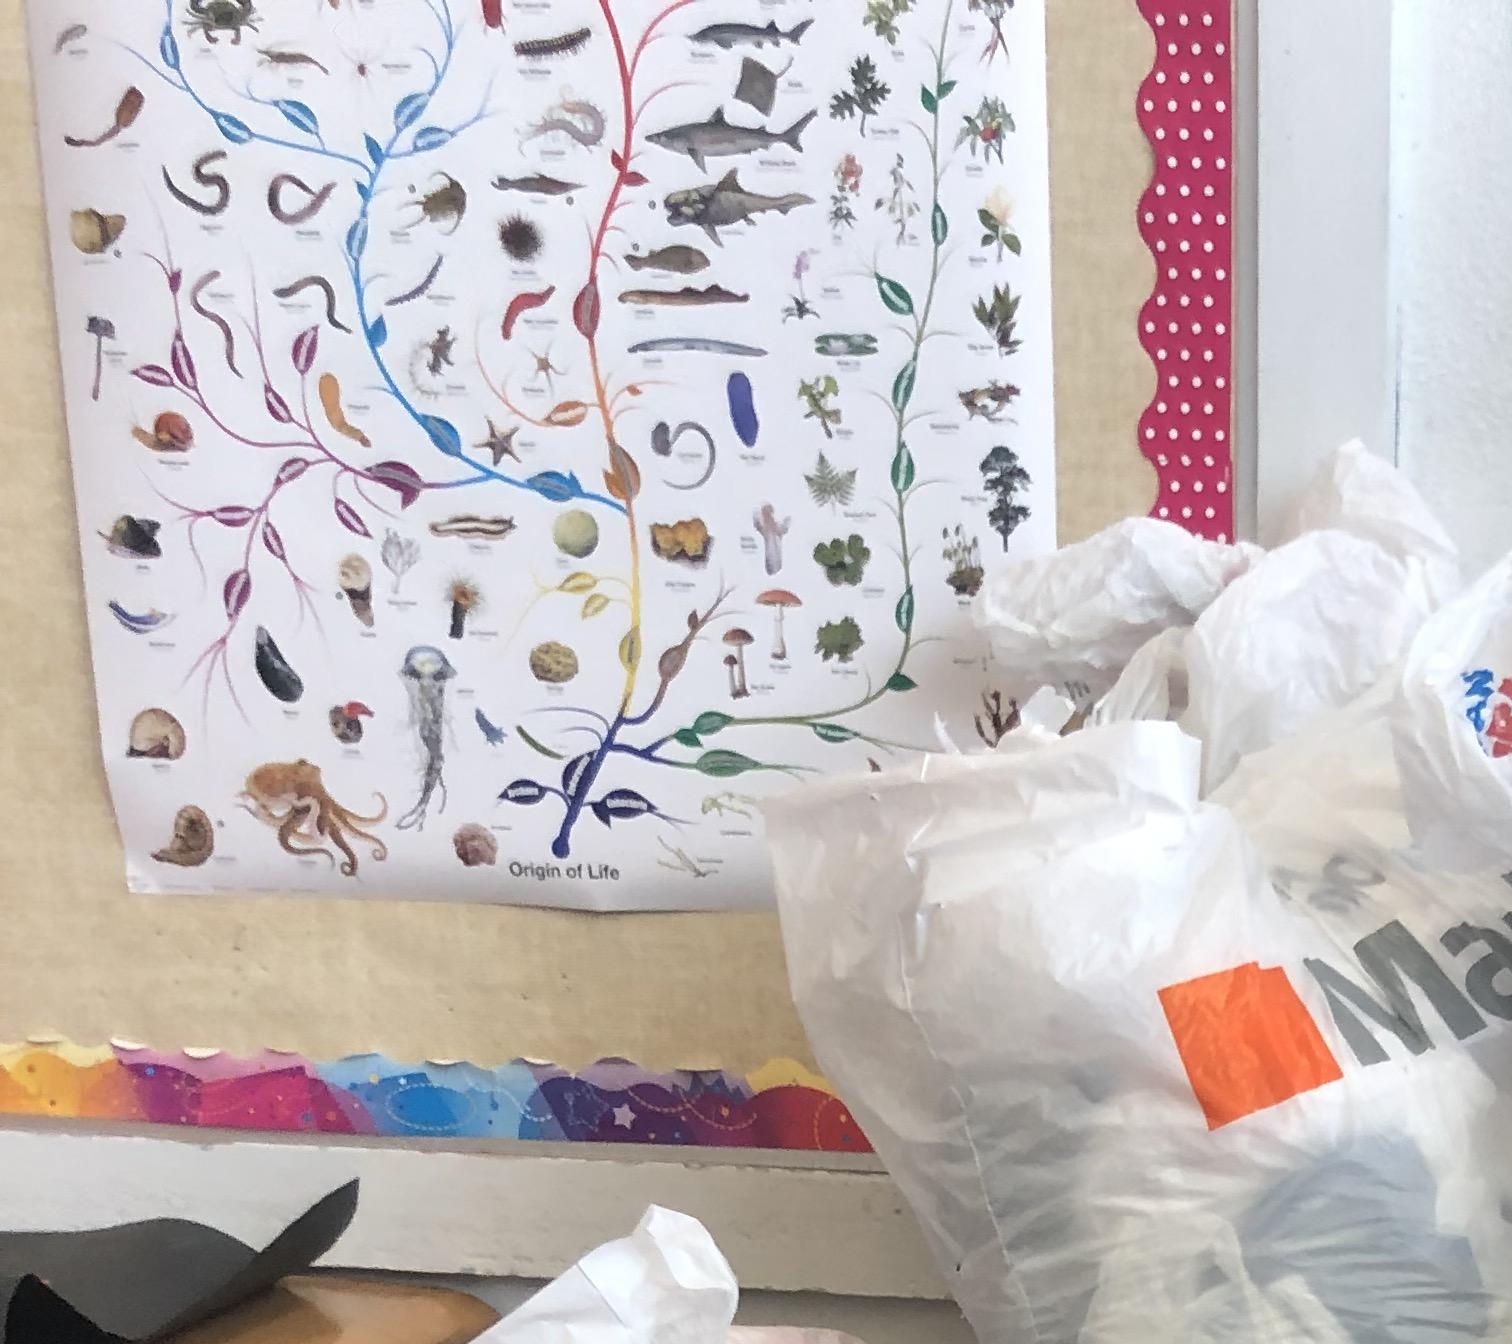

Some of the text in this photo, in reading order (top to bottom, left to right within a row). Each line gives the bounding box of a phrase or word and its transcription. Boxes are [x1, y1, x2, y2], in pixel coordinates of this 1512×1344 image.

[509, 861, 619, 881] Origin of Life
